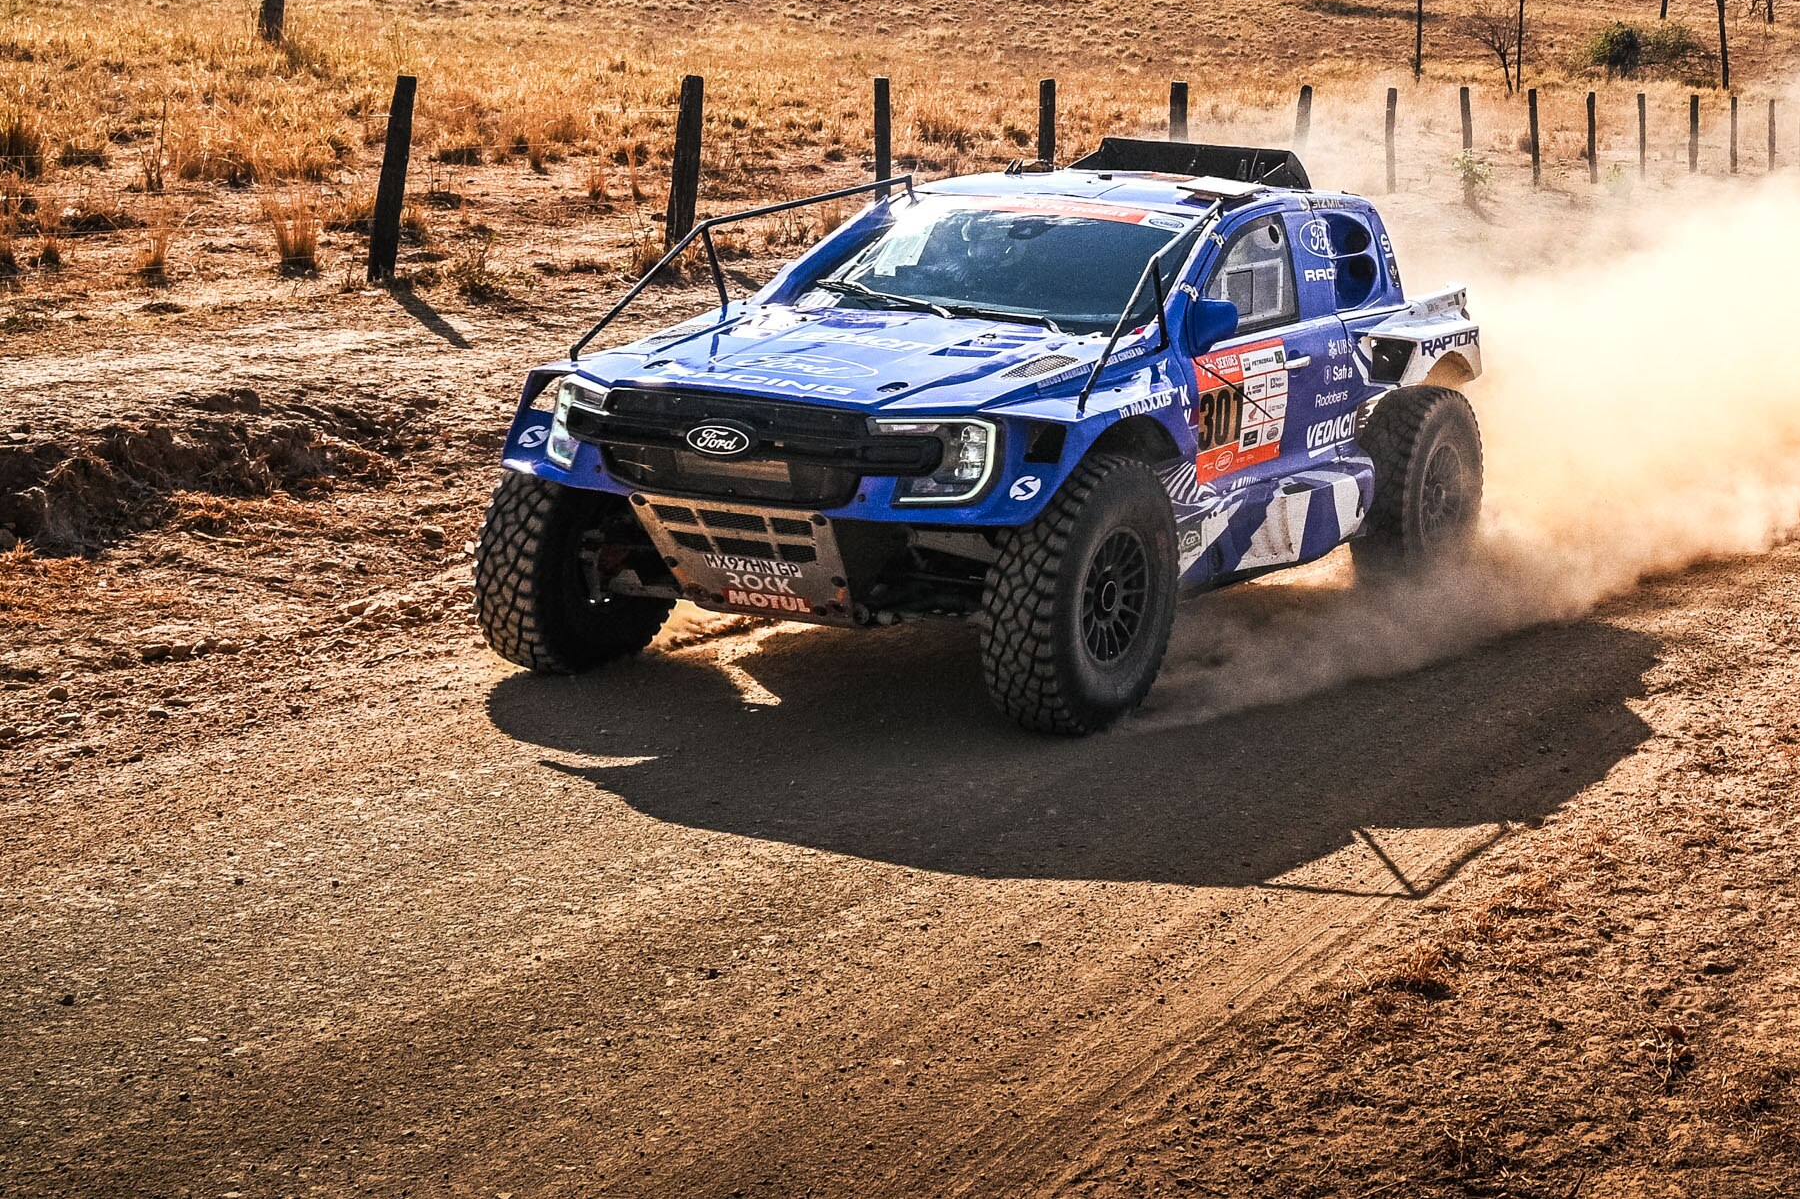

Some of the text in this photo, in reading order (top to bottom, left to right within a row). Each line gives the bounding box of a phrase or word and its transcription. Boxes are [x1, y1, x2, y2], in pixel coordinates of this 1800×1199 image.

[1336, 339, 1353, 355] UBS
[1421, 329, 1480, 359] RAPTOR
[735, 354, 850, 376] Ford
[1333, 363, 1353, 381] Safra
[658, 361, 858, 396] RACING
[1131, 394, 1172, 418] MAXXIS
[1198, 388, 1244, 450] 301
[1306, 410, 1358, 449] VEDACIT
[696, 428, 738, 452] Ford
[778, 562, 799, 577] GP
[726, 572, 796, 594] ROCK
[728, 590, 811, 612] MOTUL
